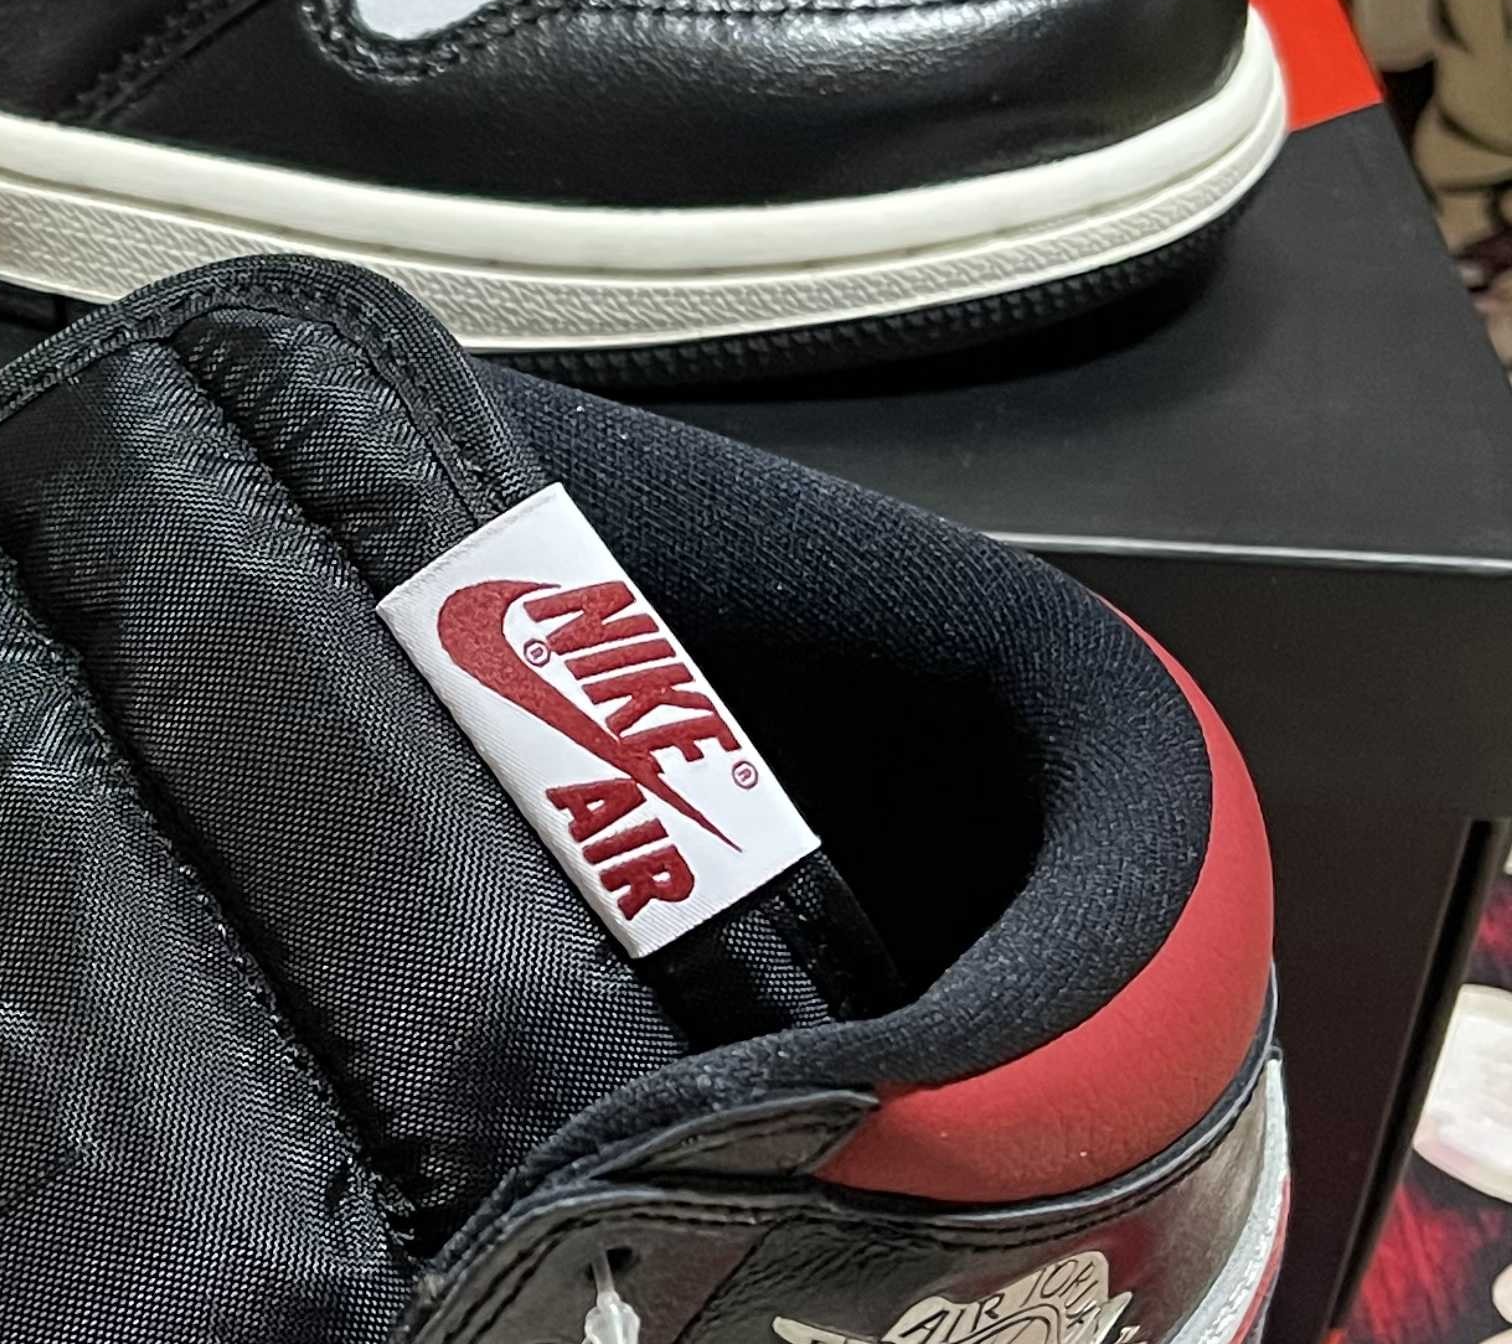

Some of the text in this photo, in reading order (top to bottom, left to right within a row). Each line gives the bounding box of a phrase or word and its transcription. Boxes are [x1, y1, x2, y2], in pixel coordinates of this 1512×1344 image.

[523, 580, 742, 775] NIKE
[545, 777, 696, 922] AIR
[899, 1293, 1006, 1344] AIR
